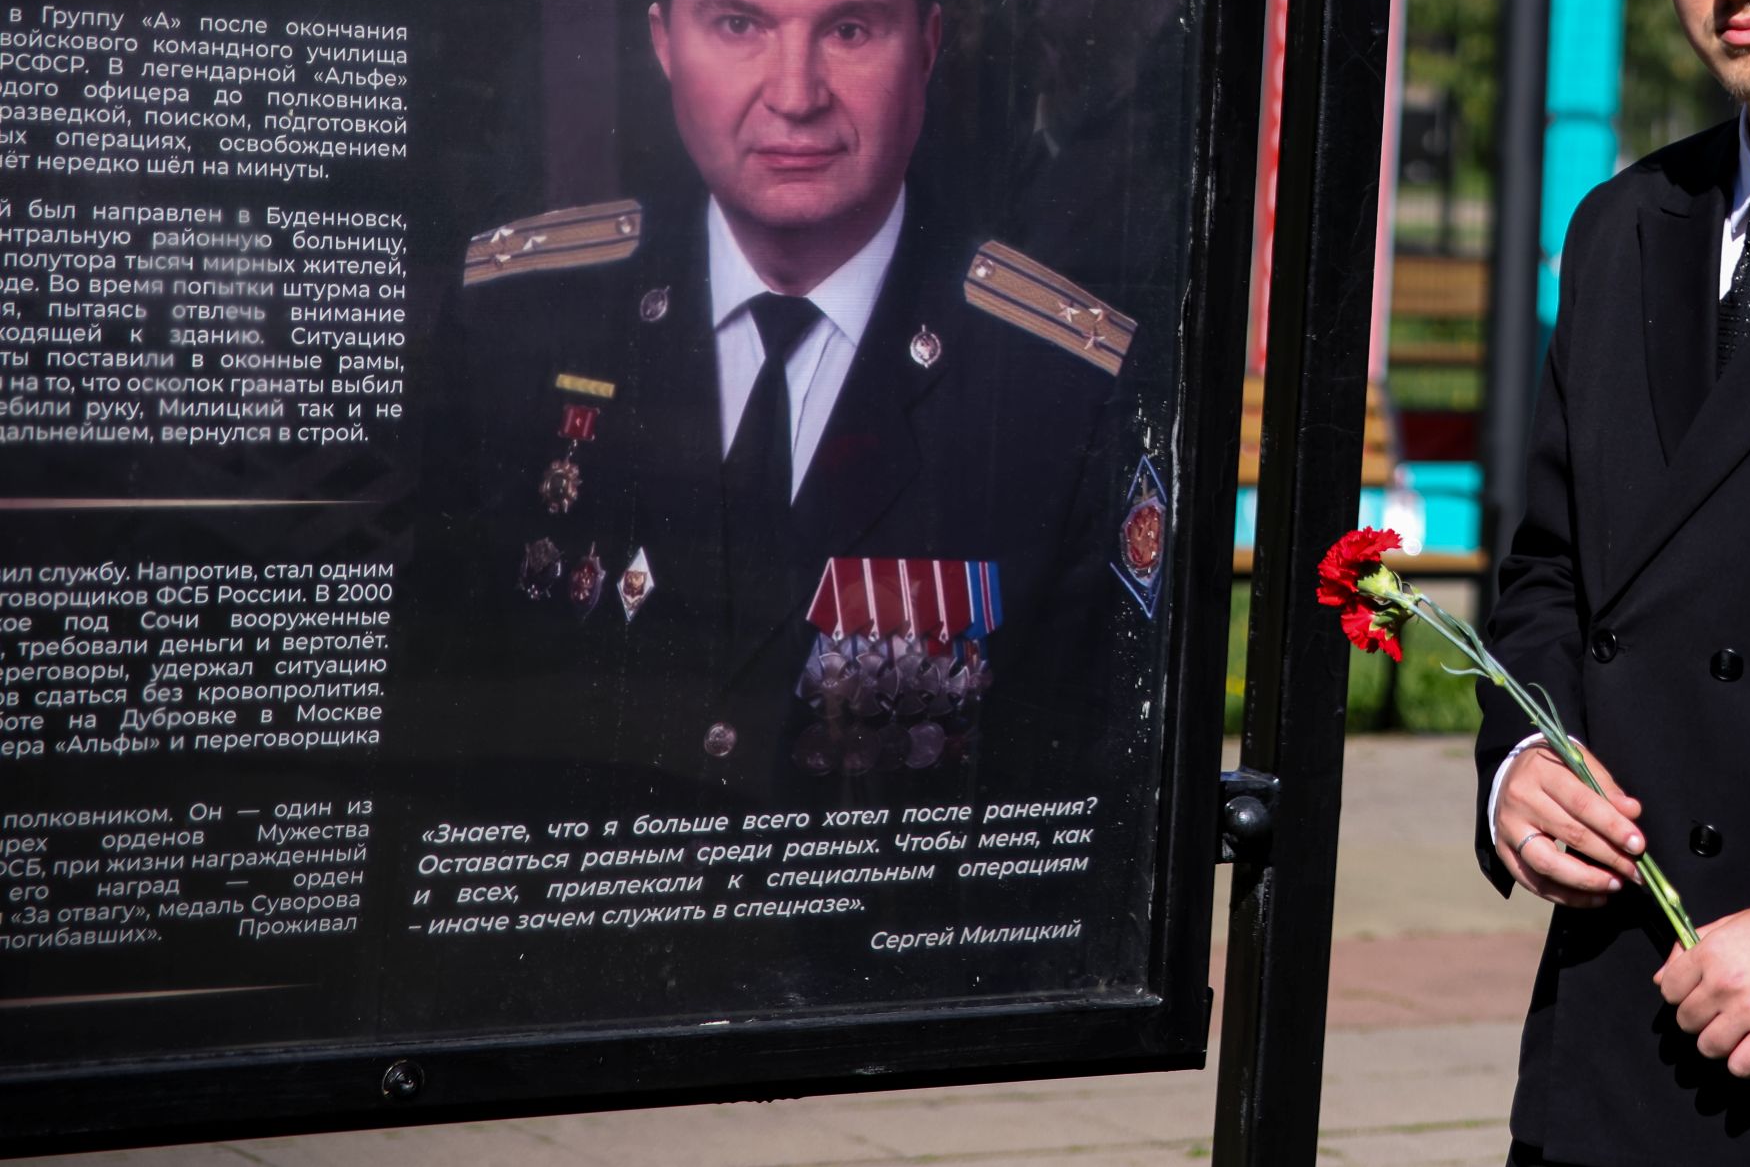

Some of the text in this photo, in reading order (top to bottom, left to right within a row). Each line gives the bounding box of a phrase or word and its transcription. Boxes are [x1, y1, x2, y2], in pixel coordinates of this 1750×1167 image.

[42, 5, 407, 41] Группу «А» после окончания
[153, 39, 293, 59] командного
[306, 46, 407, 65] училища
[0, 53, 407, 90] РСФСР. легендарной «Альфе»
[84, 80, 407, 111] офицера до полковника.
[0, 105, 406, 134] разведкой, поиском, подготовкой
[56, 132, 191, 153] операциях,
[219, 134, 406, 157] освобождением
[38, 155, 329, 181] нередко шёл на минуты.
[28, 199, 406, 231] был направлен Буденновск,
[152, 228, 272, 252] районную
[292, 230, 406, 255] больницу,
[4, 253, 406, 278] полутора тысяч мирных жителей,
[50, 274, 405, 301] Во время попытки штурма он
[48, 303, 405, 322] пытаясь отвлечь внимание
[170, 329, 264, 346] зданию.
[291, 327, 405, 349] Ситуацию
[47, 352, 174, 367] поставили
[220, 354, 322, 369] оконные
[339, 355, 404, 374] рамы,
[10, 377, 38, 391] на
[45, 377, 75, 393] то,
[82, 377, 120, 391] что
[127, 377, 224, 392] осколок
[231, 378, 324, 397] гранаты
[332, 375, 403, 393] выбил
[86, 402, 144, 420] руку,
[159, 398, 284, 419] Милицкий
[298, 403, 334, 417] так
[376, 403, 402, 417] не
[162, 426, 271, 445] вернулся
[298, 423, 368, 445] строй.
[39, 561, 393, 586] службу. Напротив, стал одним
[156, 586, 208, 605] ФСБ
[218, 585, 306, 603] России.
[337, 583, 392, 601] 2000
[64, 611, 390, 633] под Сочи вооруженные
[18, 631, 388, 661] требовали деньги вертолёт.
[0, 659, 387, 686] реговоры, удержал ситуацию
[35, 682, 384, 707] сдаться без кровопролития.
[69, 704, 382, 731] на Дубровке Москве
[1, 730, 380, 759] ера «Альфы» переговорщика
[4, 801, 372, 829] полковником. Он один из
[422, 797, 1098, 843] «Знаете, что больше всего хотел после ранения?
[102, 824, 370, 852] орденов Мужества
[54, 843, 366, 878] при жизни награжденный
[418, 829, 1094, 875] Оставаться равным среди равных. Чтобы меня, как
[8, 871, 364, 901] его наград орден
[456, 857, 1089, 903] всех, привлекали специальным операциям
[11, 906, 50, 924] «За
[58, 905, 150, 923] отвагу»,
[158, 900, 244, 918] медаль
[252, 894, 360, 916] Суворова
[428, 898, 865, 934] иначе зачем служить спецназе».
[238, 917, 357, 939] Проживал
[871, 919, 1082, 953] Сергей Милицкий
